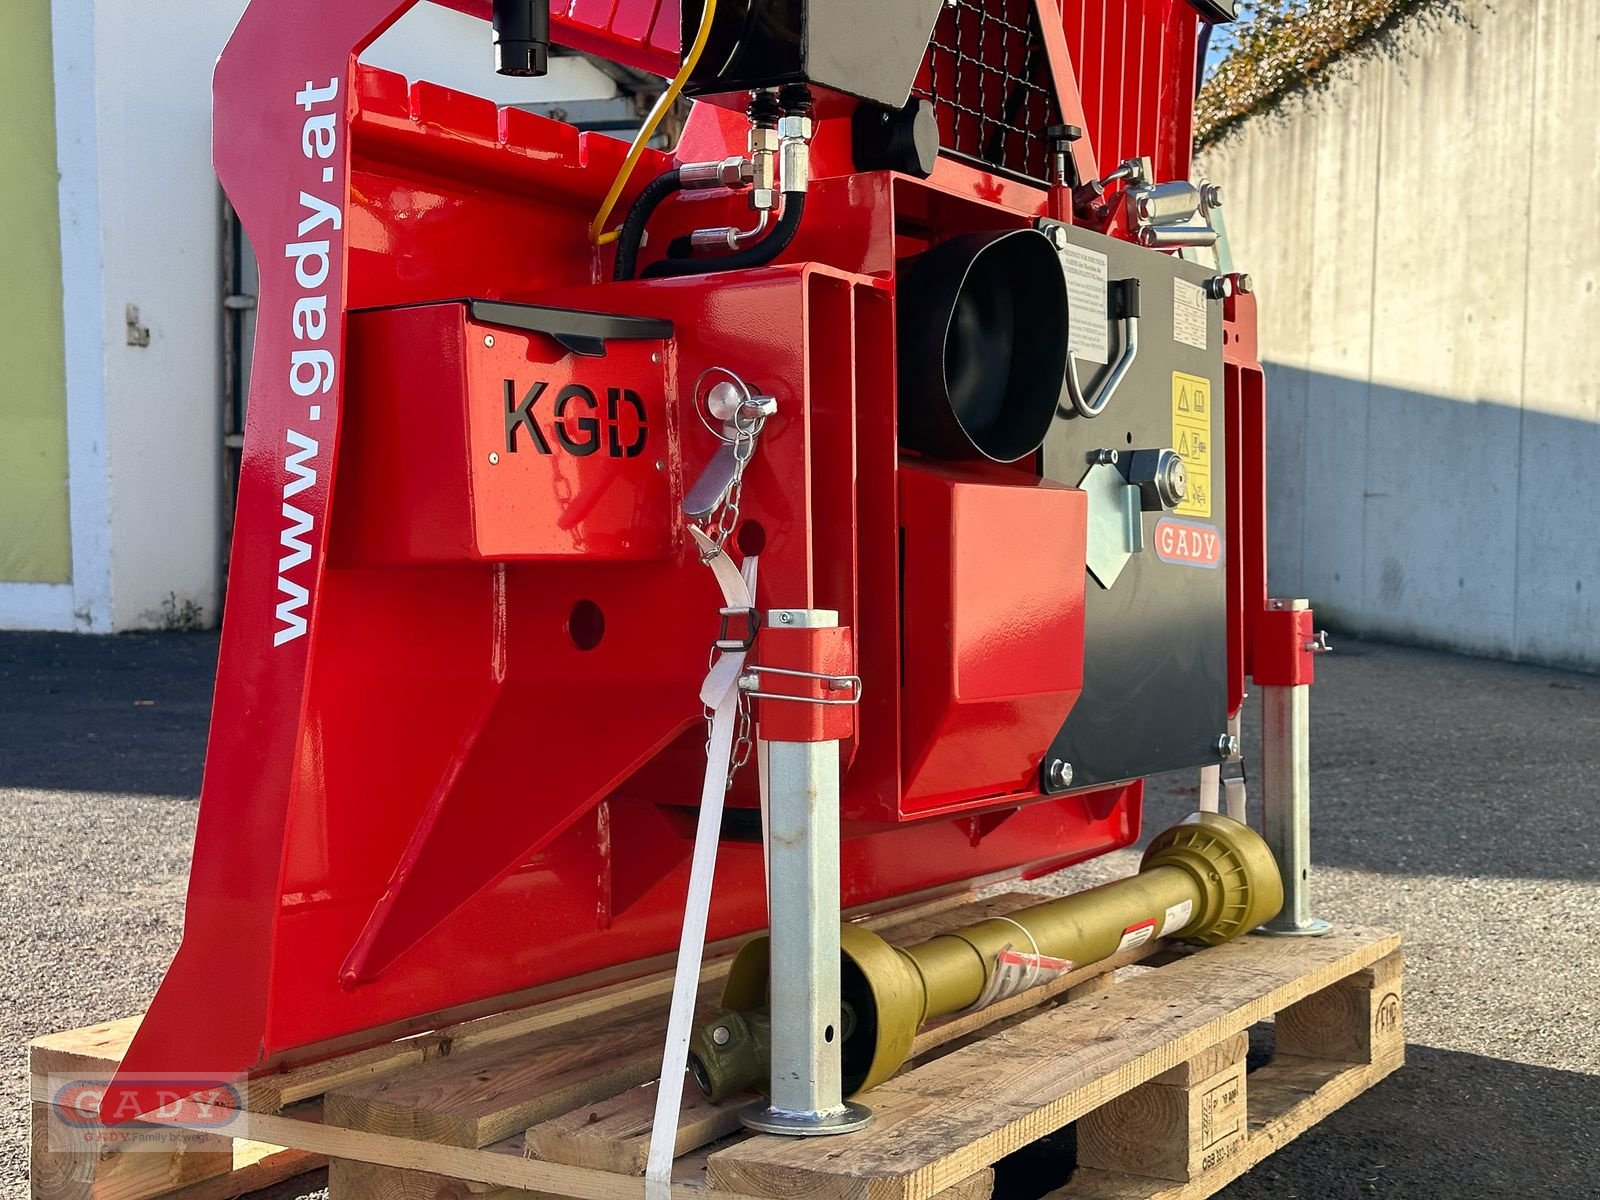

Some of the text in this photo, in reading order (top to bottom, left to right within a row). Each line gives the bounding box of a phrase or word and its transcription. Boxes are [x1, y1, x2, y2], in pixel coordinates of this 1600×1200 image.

[273, 76, 342, 648] www.gady.at
[503, 378, 650, 459] KGD
[1161, 526, 1216, 560] GADY
